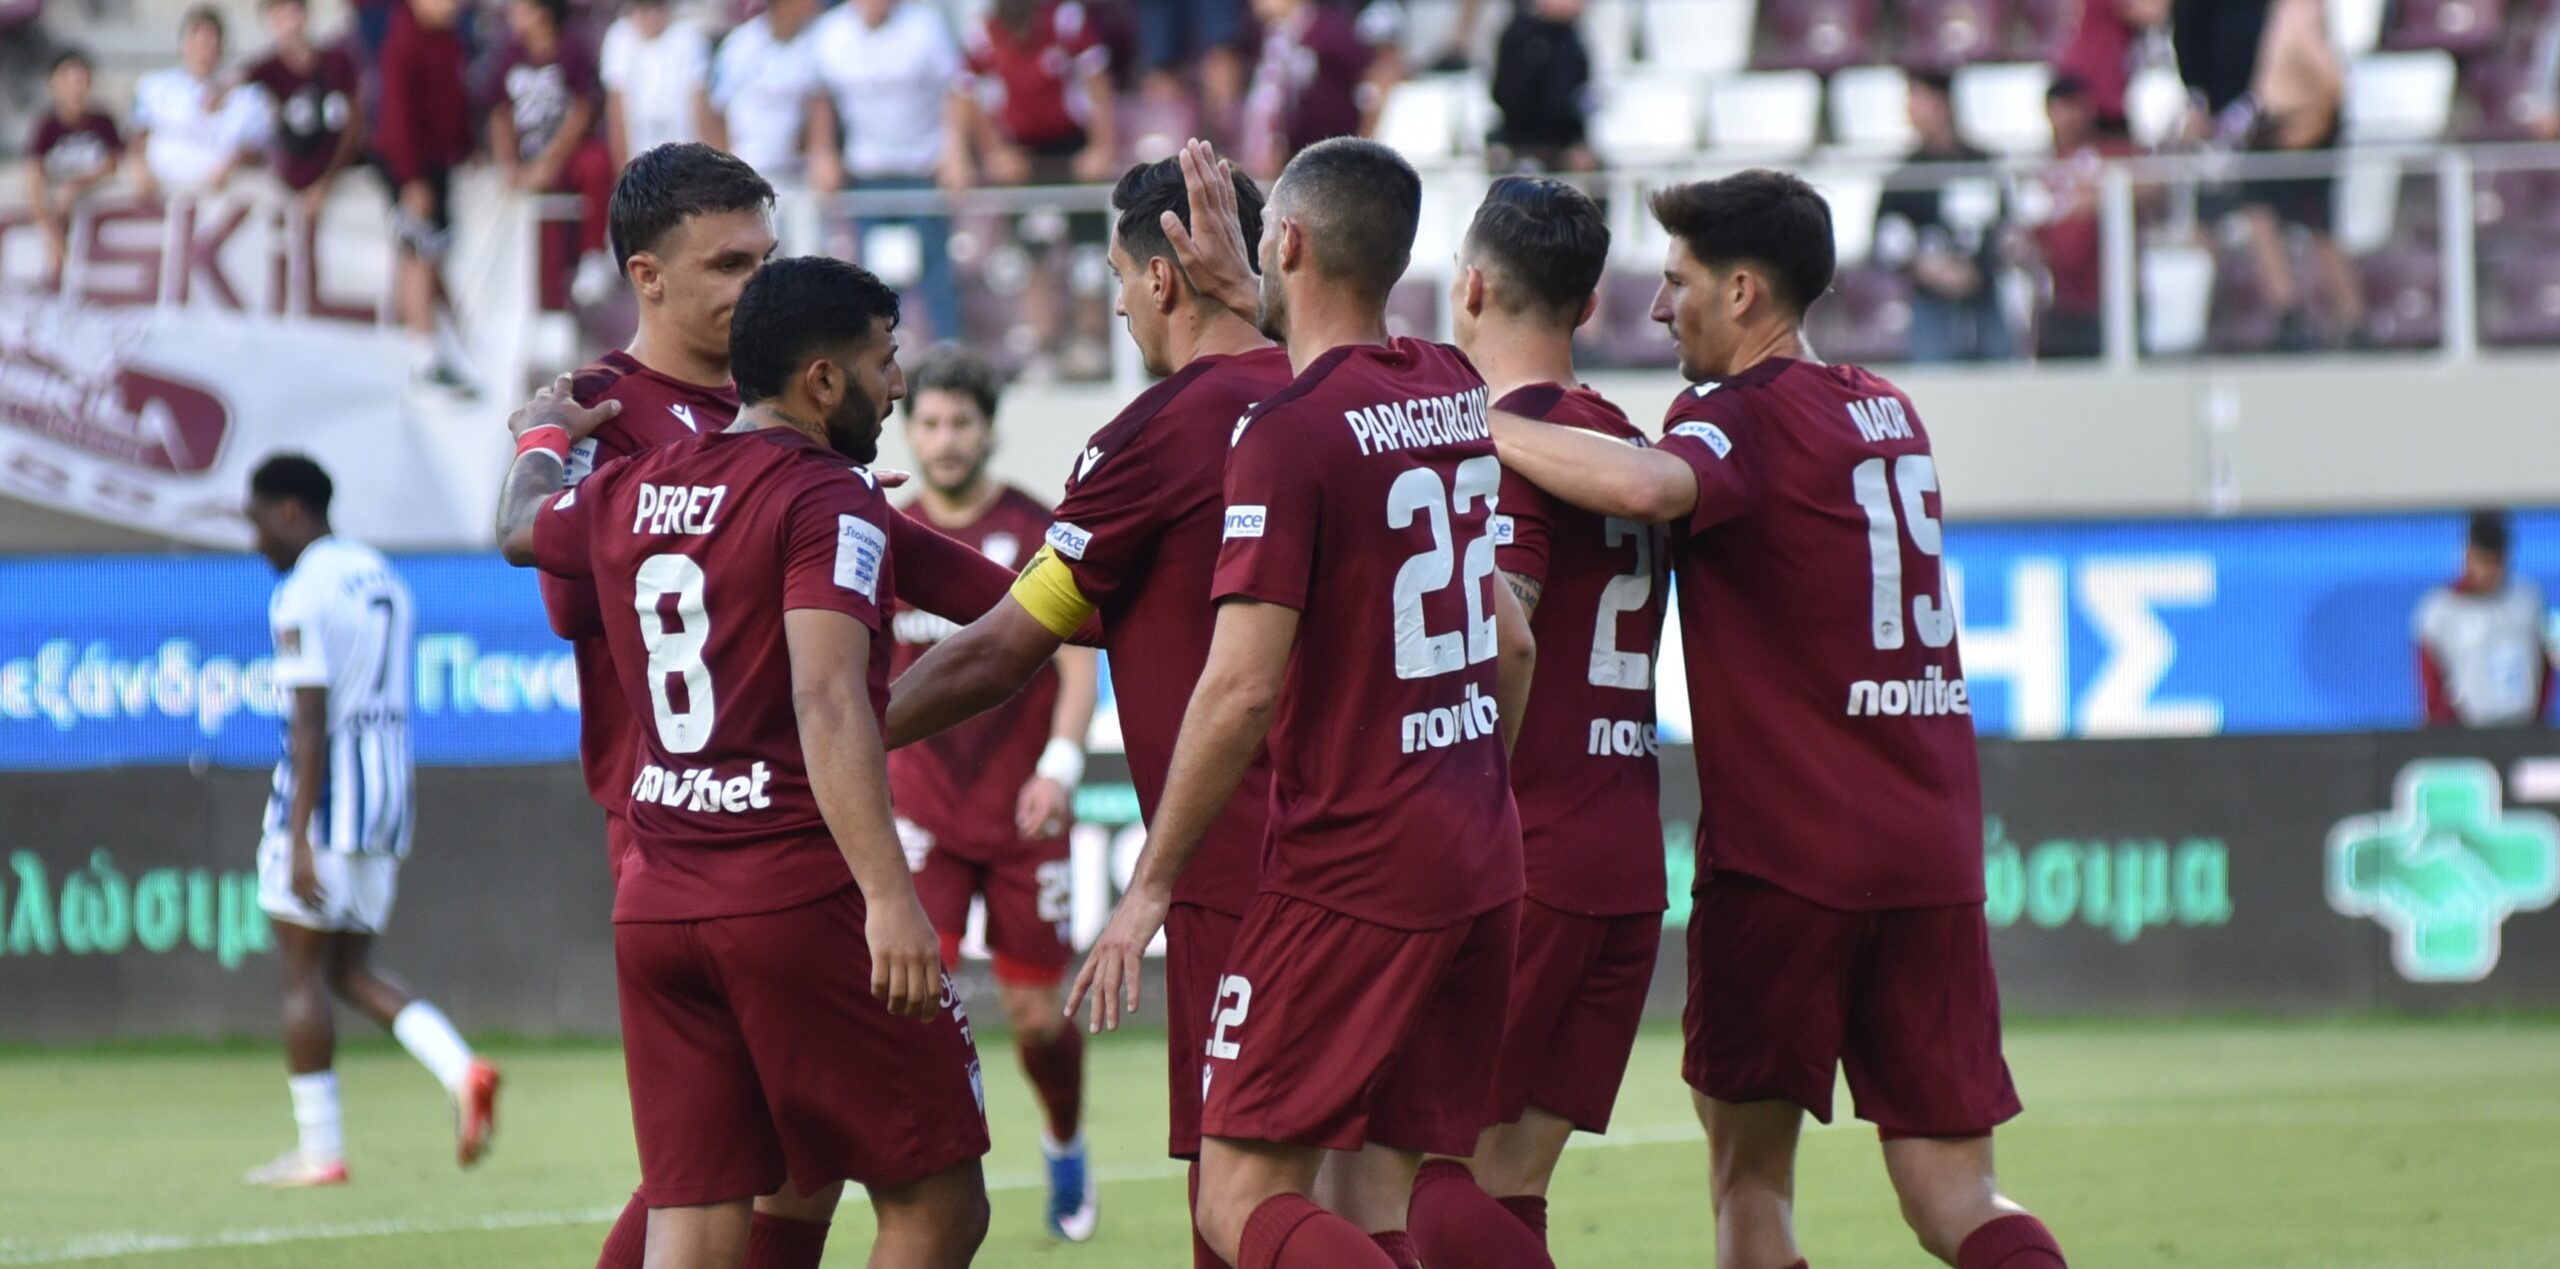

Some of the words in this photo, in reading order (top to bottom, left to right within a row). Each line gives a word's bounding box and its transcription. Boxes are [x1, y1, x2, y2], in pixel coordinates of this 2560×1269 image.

[1344, 385, 1490, 456] PAPAGEORGIOU
[1846, 396, 1914, 442] NAOR
[633, 483, 727, 534] PEREZ
[1387, 455, 1501, 680] 22
[1853, 455, 1955, 650] 15
[368, 597, 394, 693] 7
[635, 554, 715, 753] 8
[1588, 516, 1660, 690] 2
